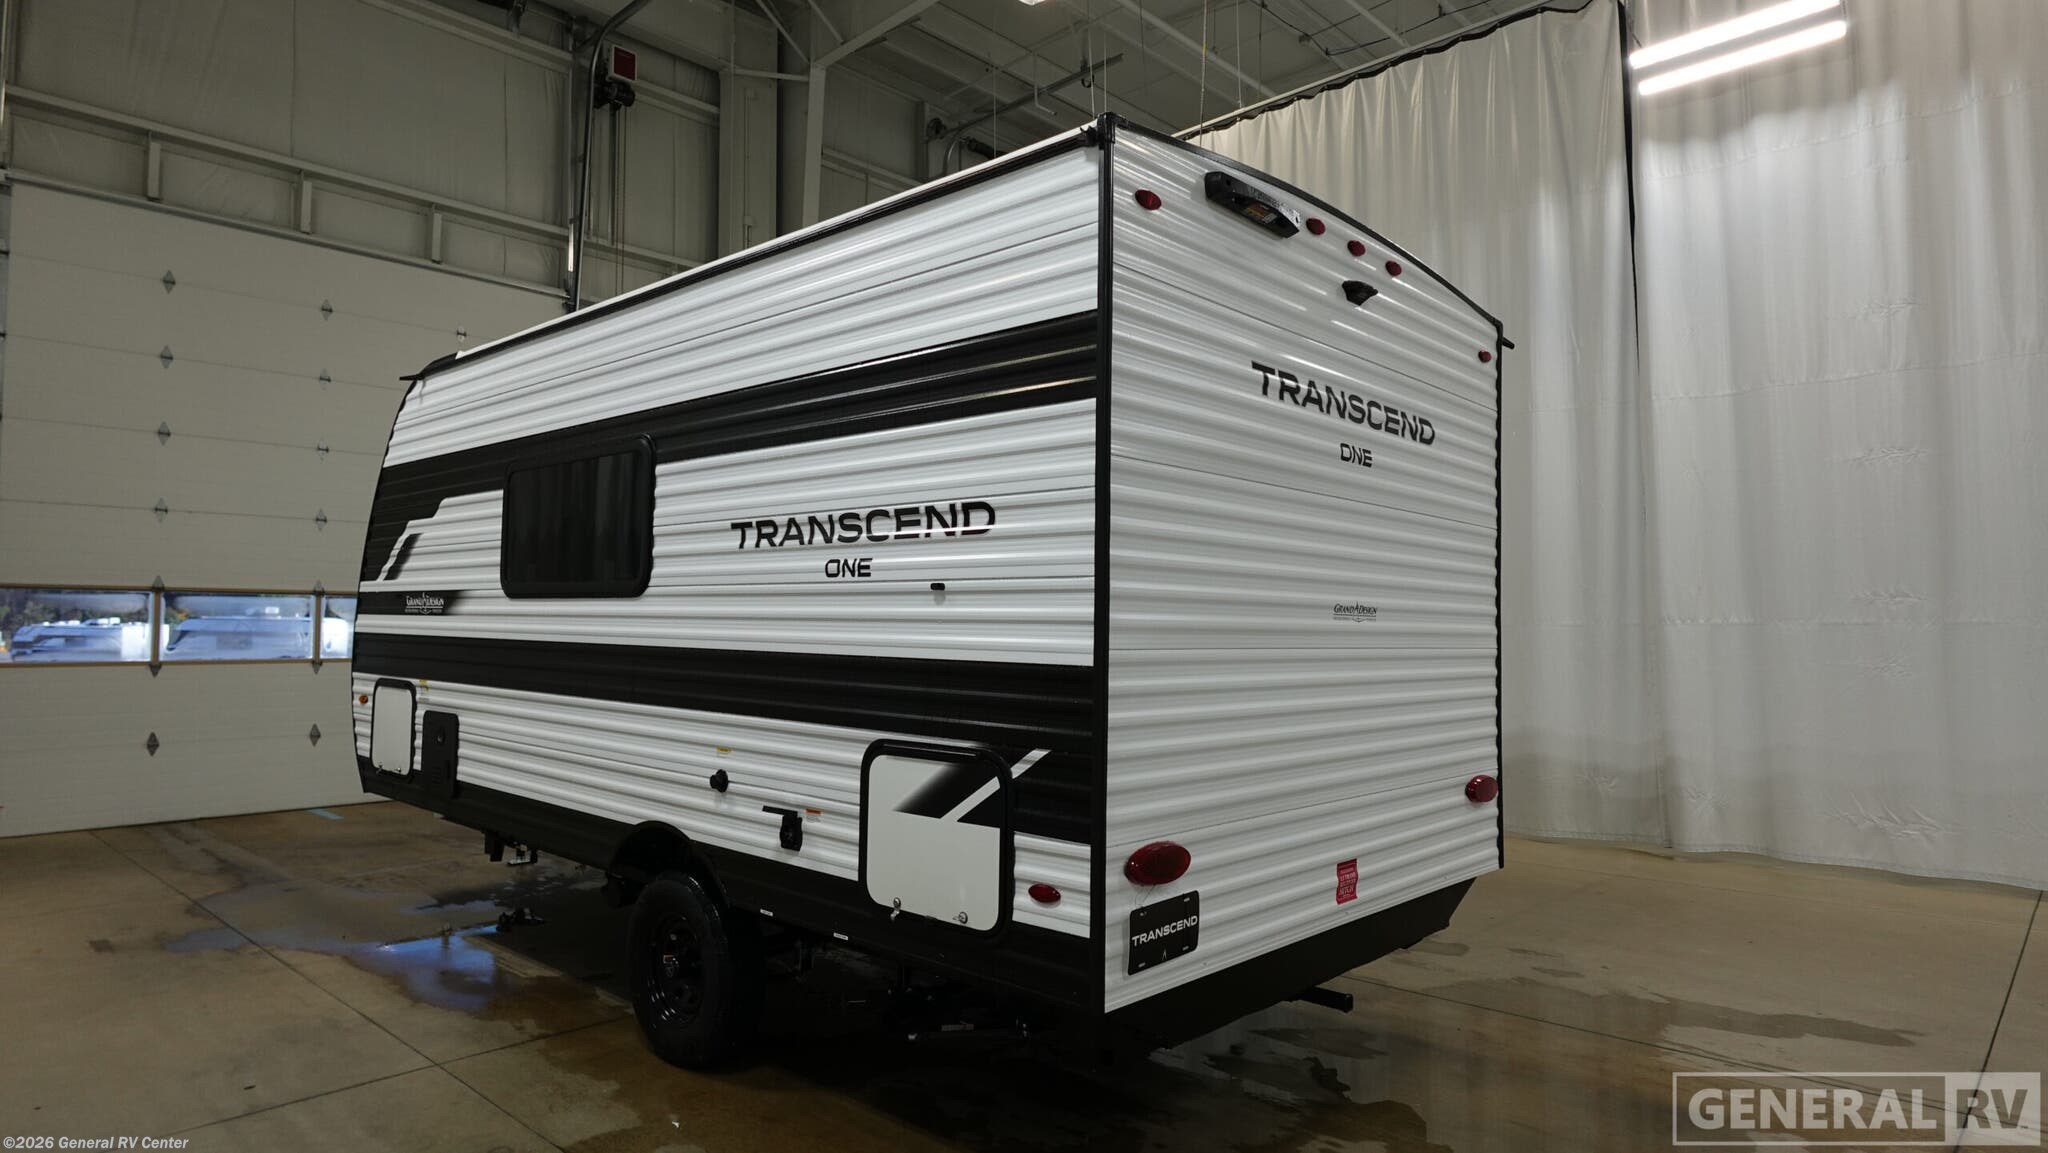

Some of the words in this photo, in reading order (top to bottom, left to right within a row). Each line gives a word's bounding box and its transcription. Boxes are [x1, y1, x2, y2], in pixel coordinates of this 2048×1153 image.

[1251, 360, 1436, 446] TRANSCEND
[1339, 442, 1373, 468] ONE
[730, 500, 996, 550] TRANSCEND
[824, 557, 873, 578] ONE
[1131, 915, 1199, 947] TRANSCEND
